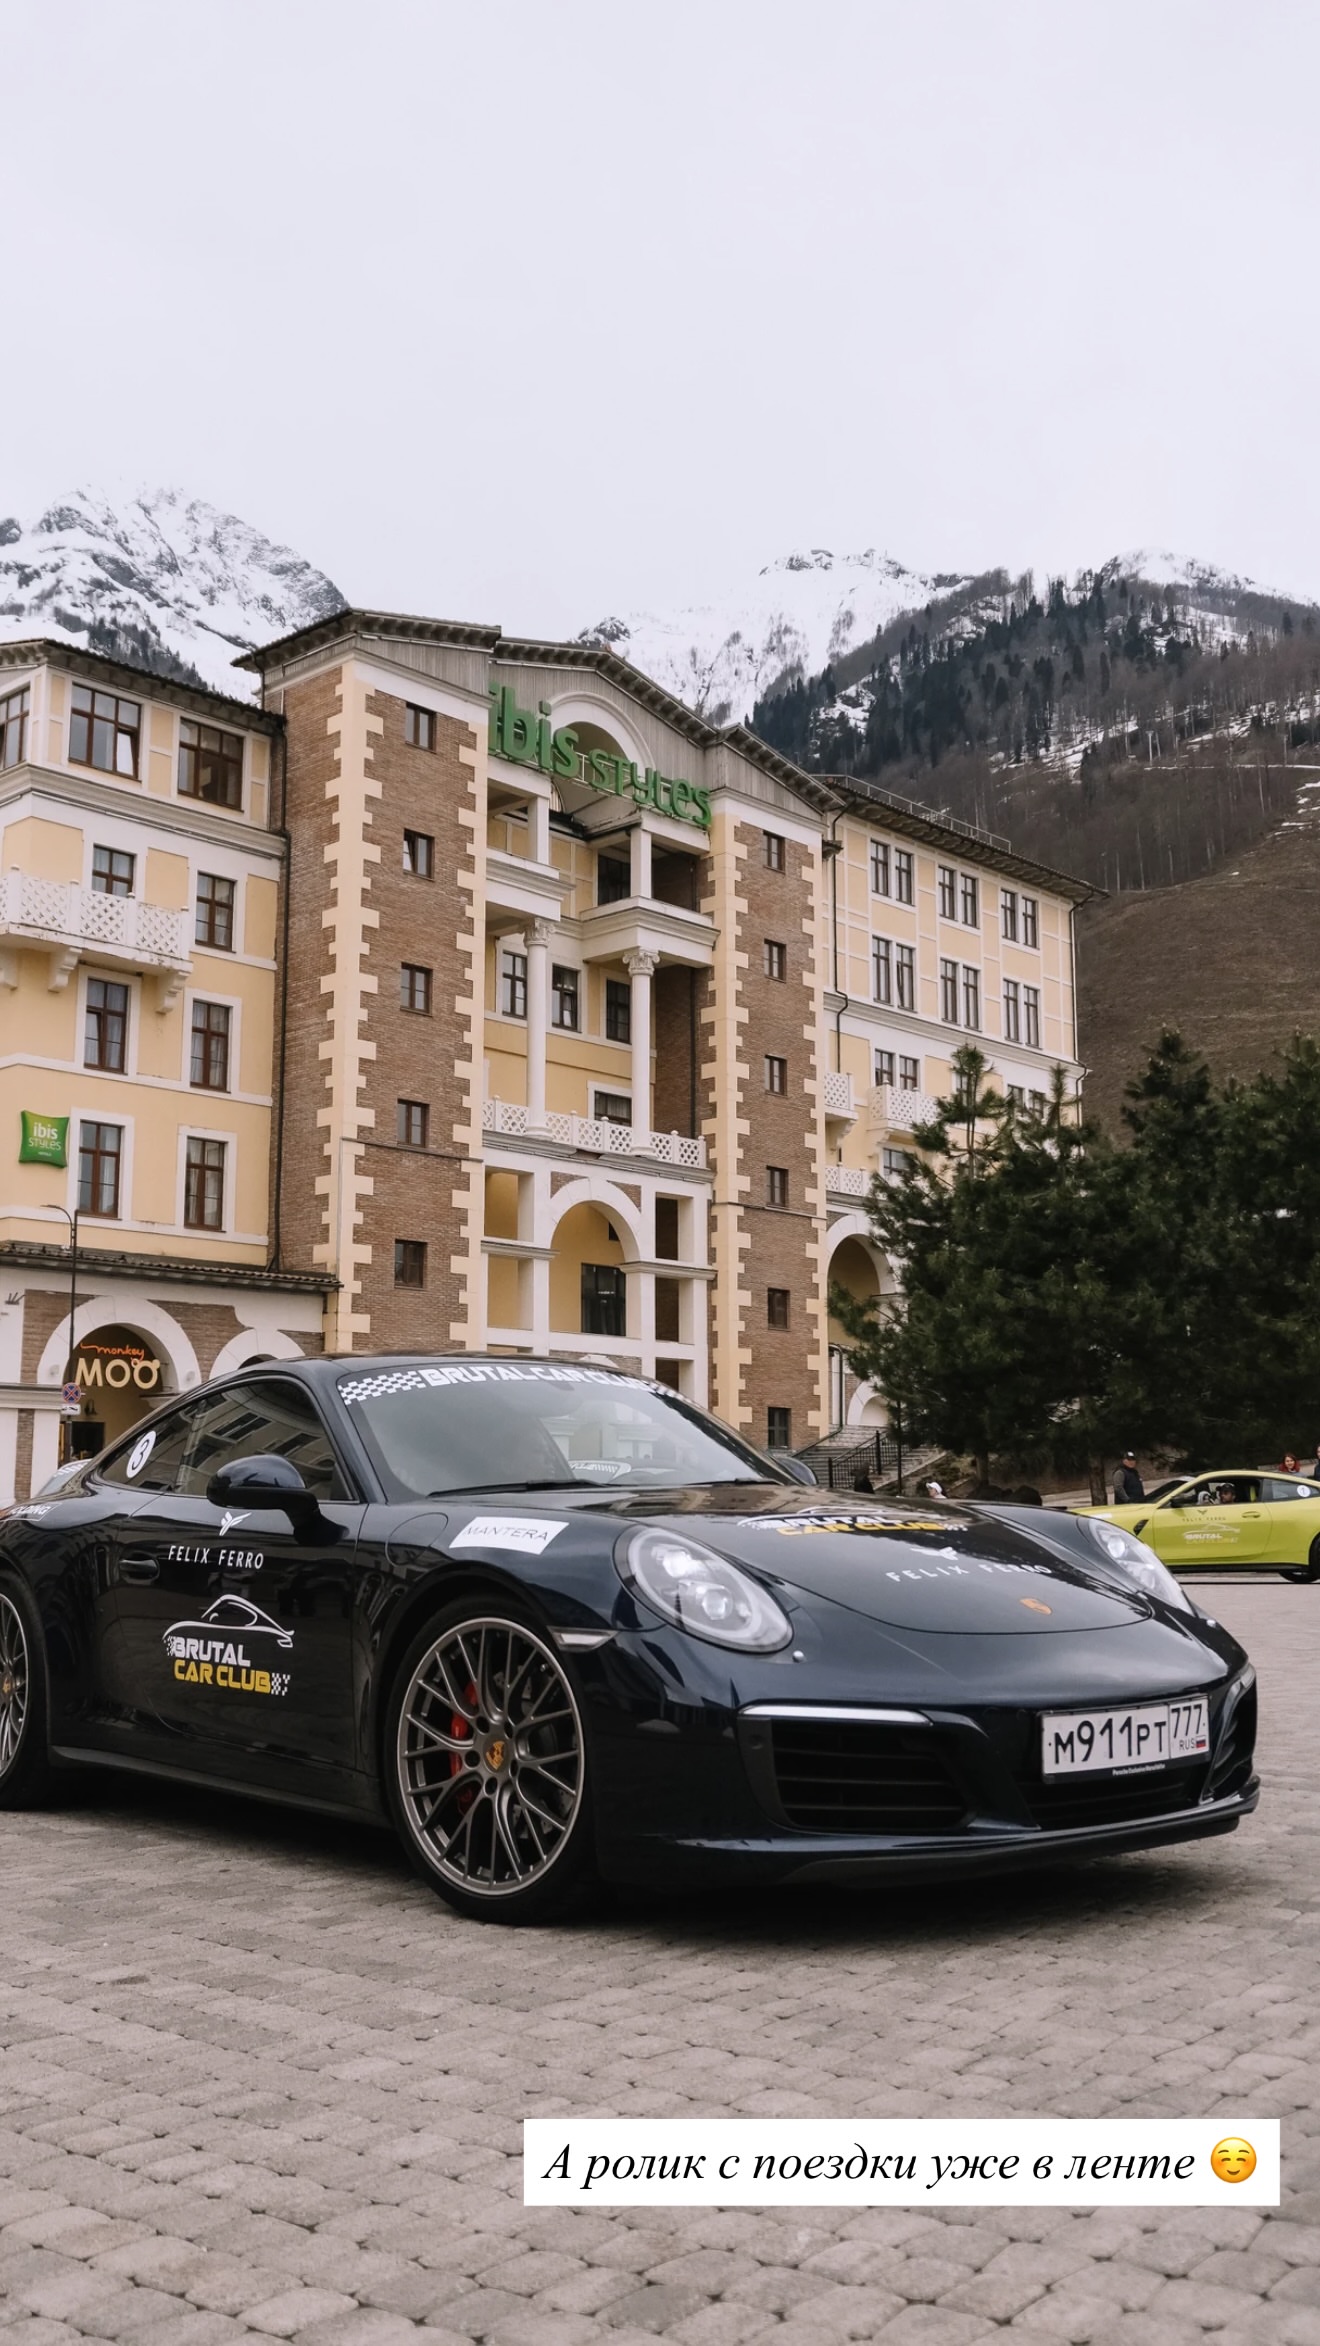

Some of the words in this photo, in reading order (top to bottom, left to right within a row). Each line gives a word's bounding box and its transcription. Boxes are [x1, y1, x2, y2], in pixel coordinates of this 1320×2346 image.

[488, 682, 580, 777] ibis
[33, 1122, 58, 1139] ibis
[80, 1343, 145, 1362] monkey
[75, 1357, 160, 1390] MOO
[419, 1366, 539, 1386] BRUTAL
[530, 1367, 593, 1383] CAR
[131, 1438, 150, 1471] 3
[463, 1526, 549, 1541] MANTERA
[776, 1522, 854, 1535] CAR
[855, 1521, 945, 1531] CLUB
[168, 1545, 210, 1564] FELIX
[218, 1549, 264, 1569] FERRO
[886, 1565, 970, 1582] FELIX
[978, 1564, 1052, 1573] FERRO
[171, 1636, 250, 1667] BRUTAL
[174, 1659, 213, 1685] CAR
[216, 1665, 272, 1694] CLUB
[1171, 1703, 1203, 1738] 777
[1179, 1738, 1196, 1751] RUS
